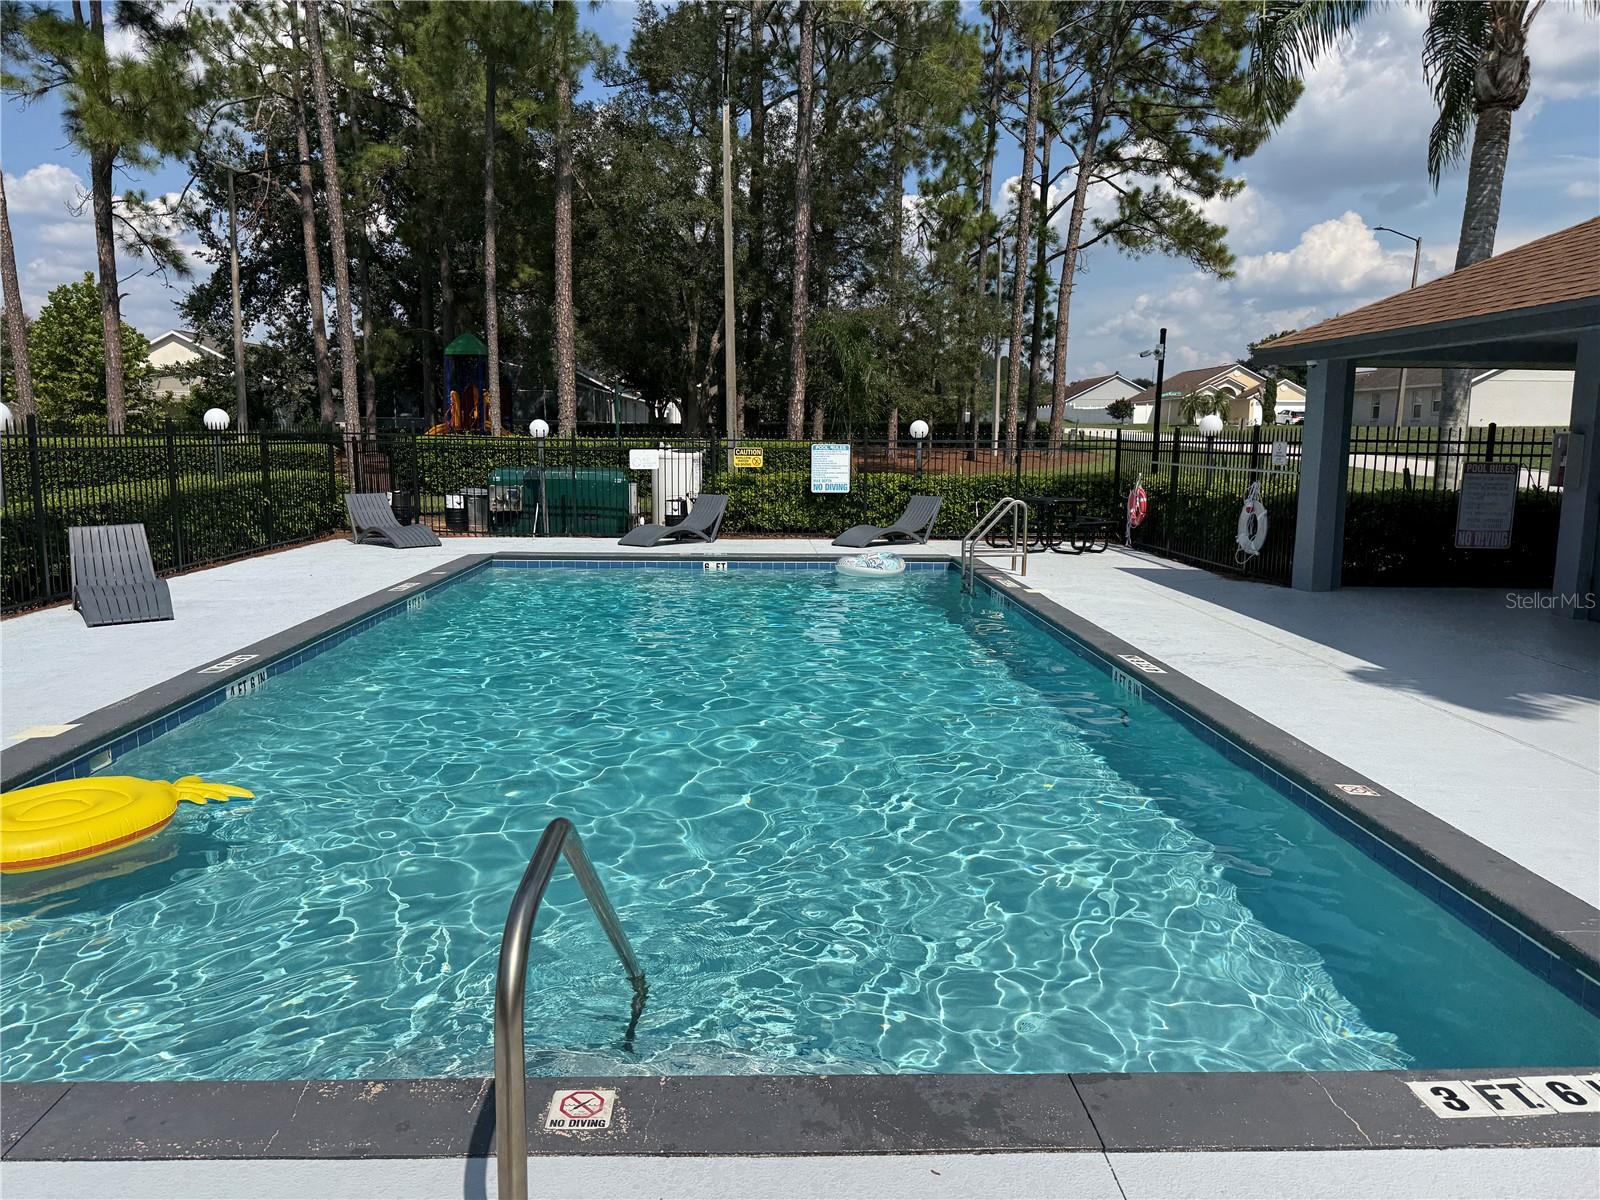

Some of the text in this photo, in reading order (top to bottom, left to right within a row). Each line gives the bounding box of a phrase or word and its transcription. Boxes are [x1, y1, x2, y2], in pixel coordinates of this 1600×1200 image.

[1466, 464, 1515, 473] POOL RULES
[813, 483, 848, 491] NO DIVING
[1458, 532, 1508, 545] NO DIVING
[716, 563, 726, 571] FT
[238, 680, 247, 695] FT
[258, 671, 265, 684] IN
[1430, 1086, 1470, 1112] 3
[1472, 1083, 1545, 1111] FT.
[1545, 1081, 1588, 1105] 6
[549, 1119, 606, 1128] NO DIVING
